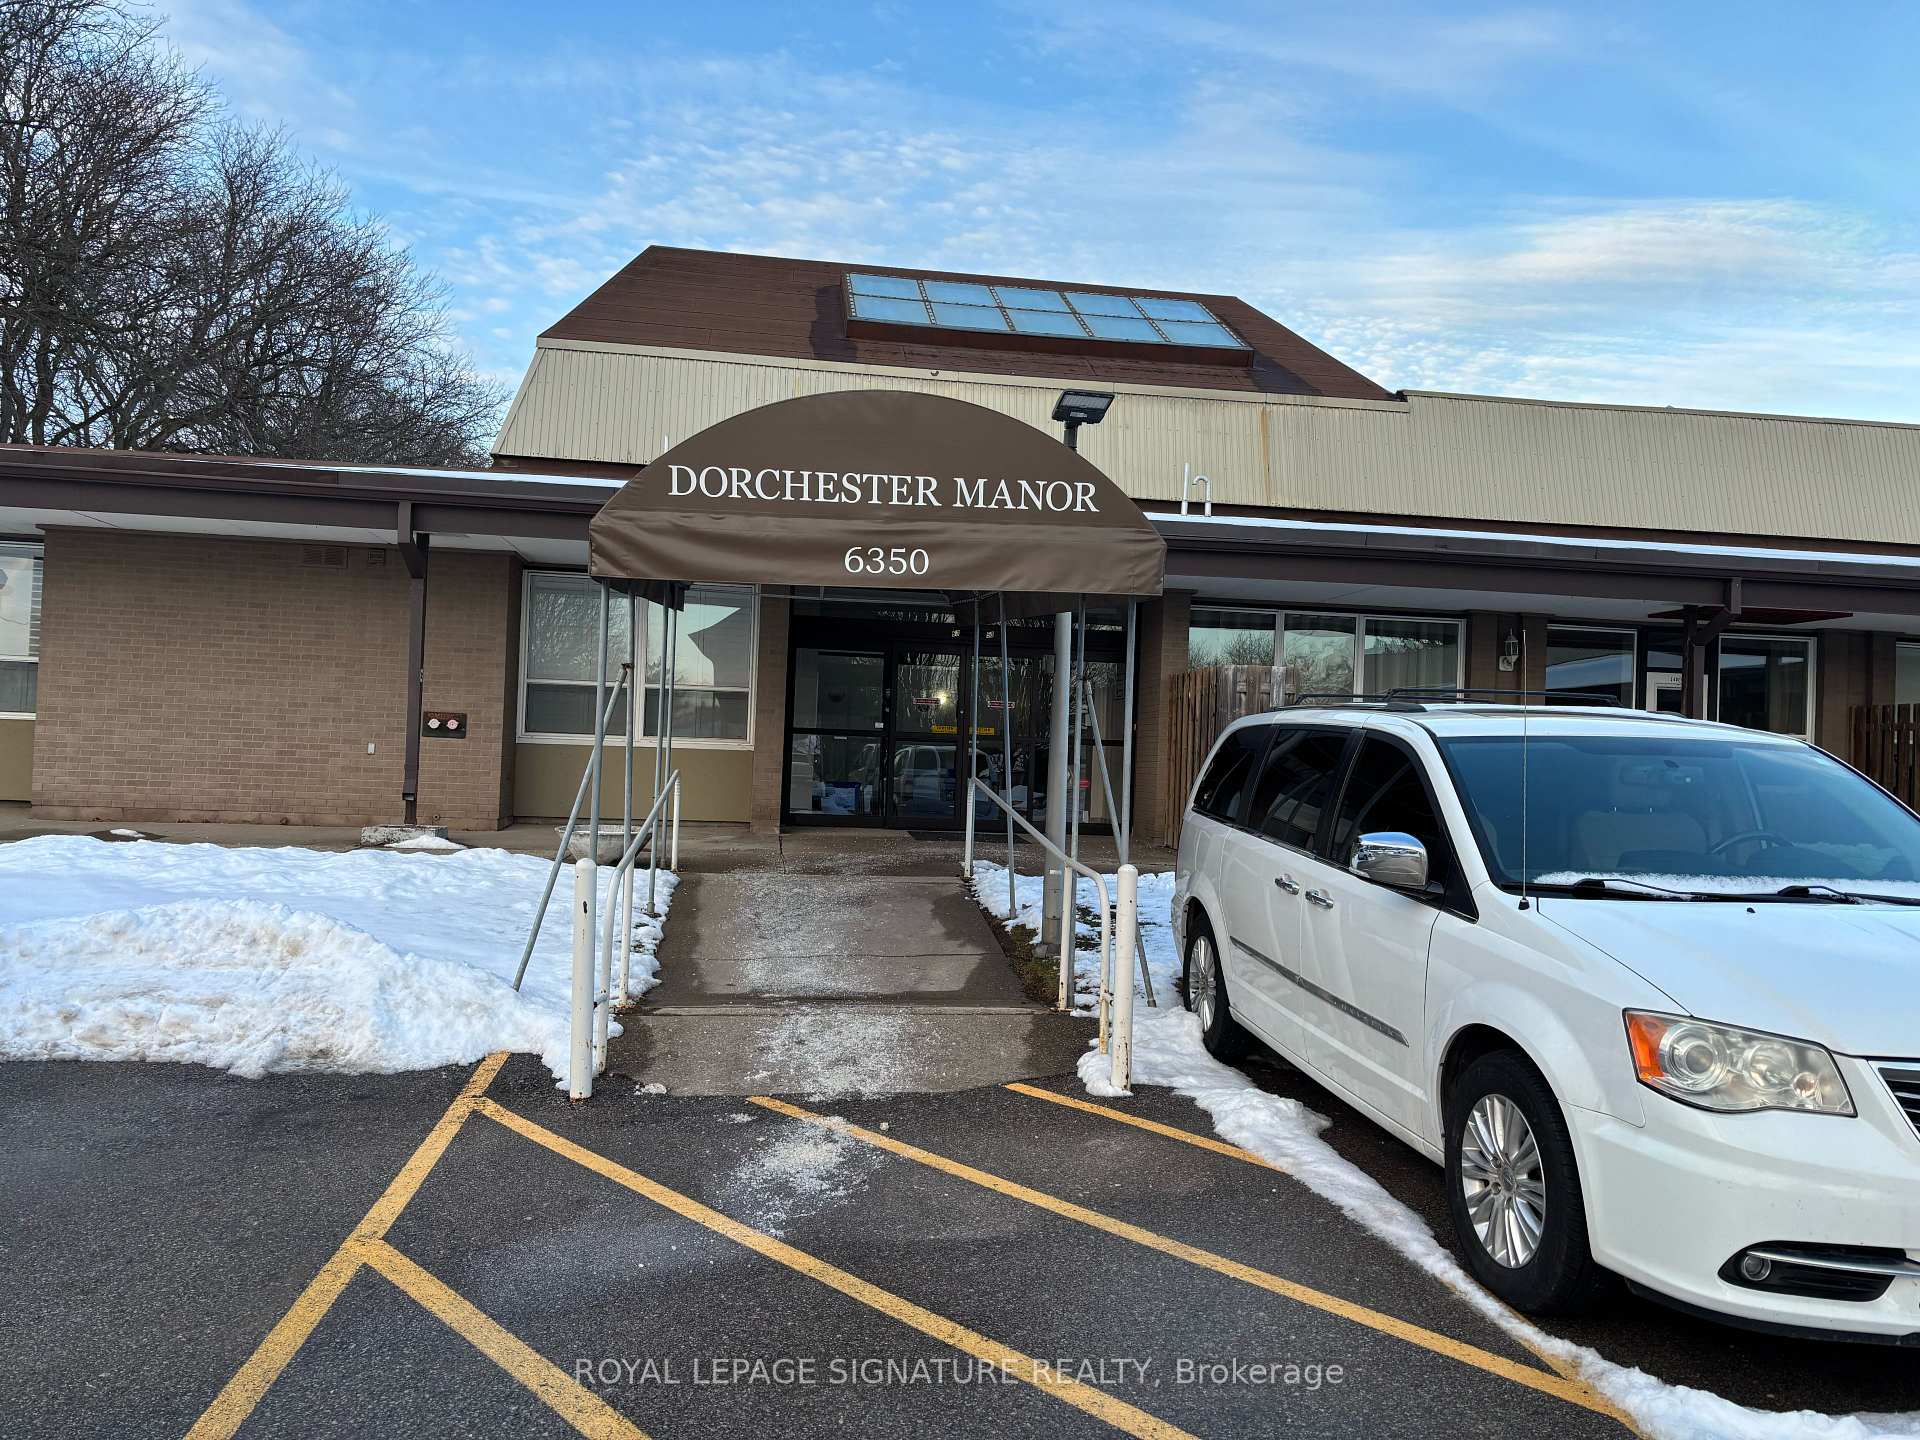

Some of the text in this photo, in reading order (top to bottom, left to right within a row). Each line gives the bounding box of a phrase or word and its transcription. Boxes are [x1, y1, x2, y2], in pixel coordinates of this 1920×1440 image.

[668, 464, 1101, 513] DORCHESTER MANOR
[844, 546, 930, 575] 6350
